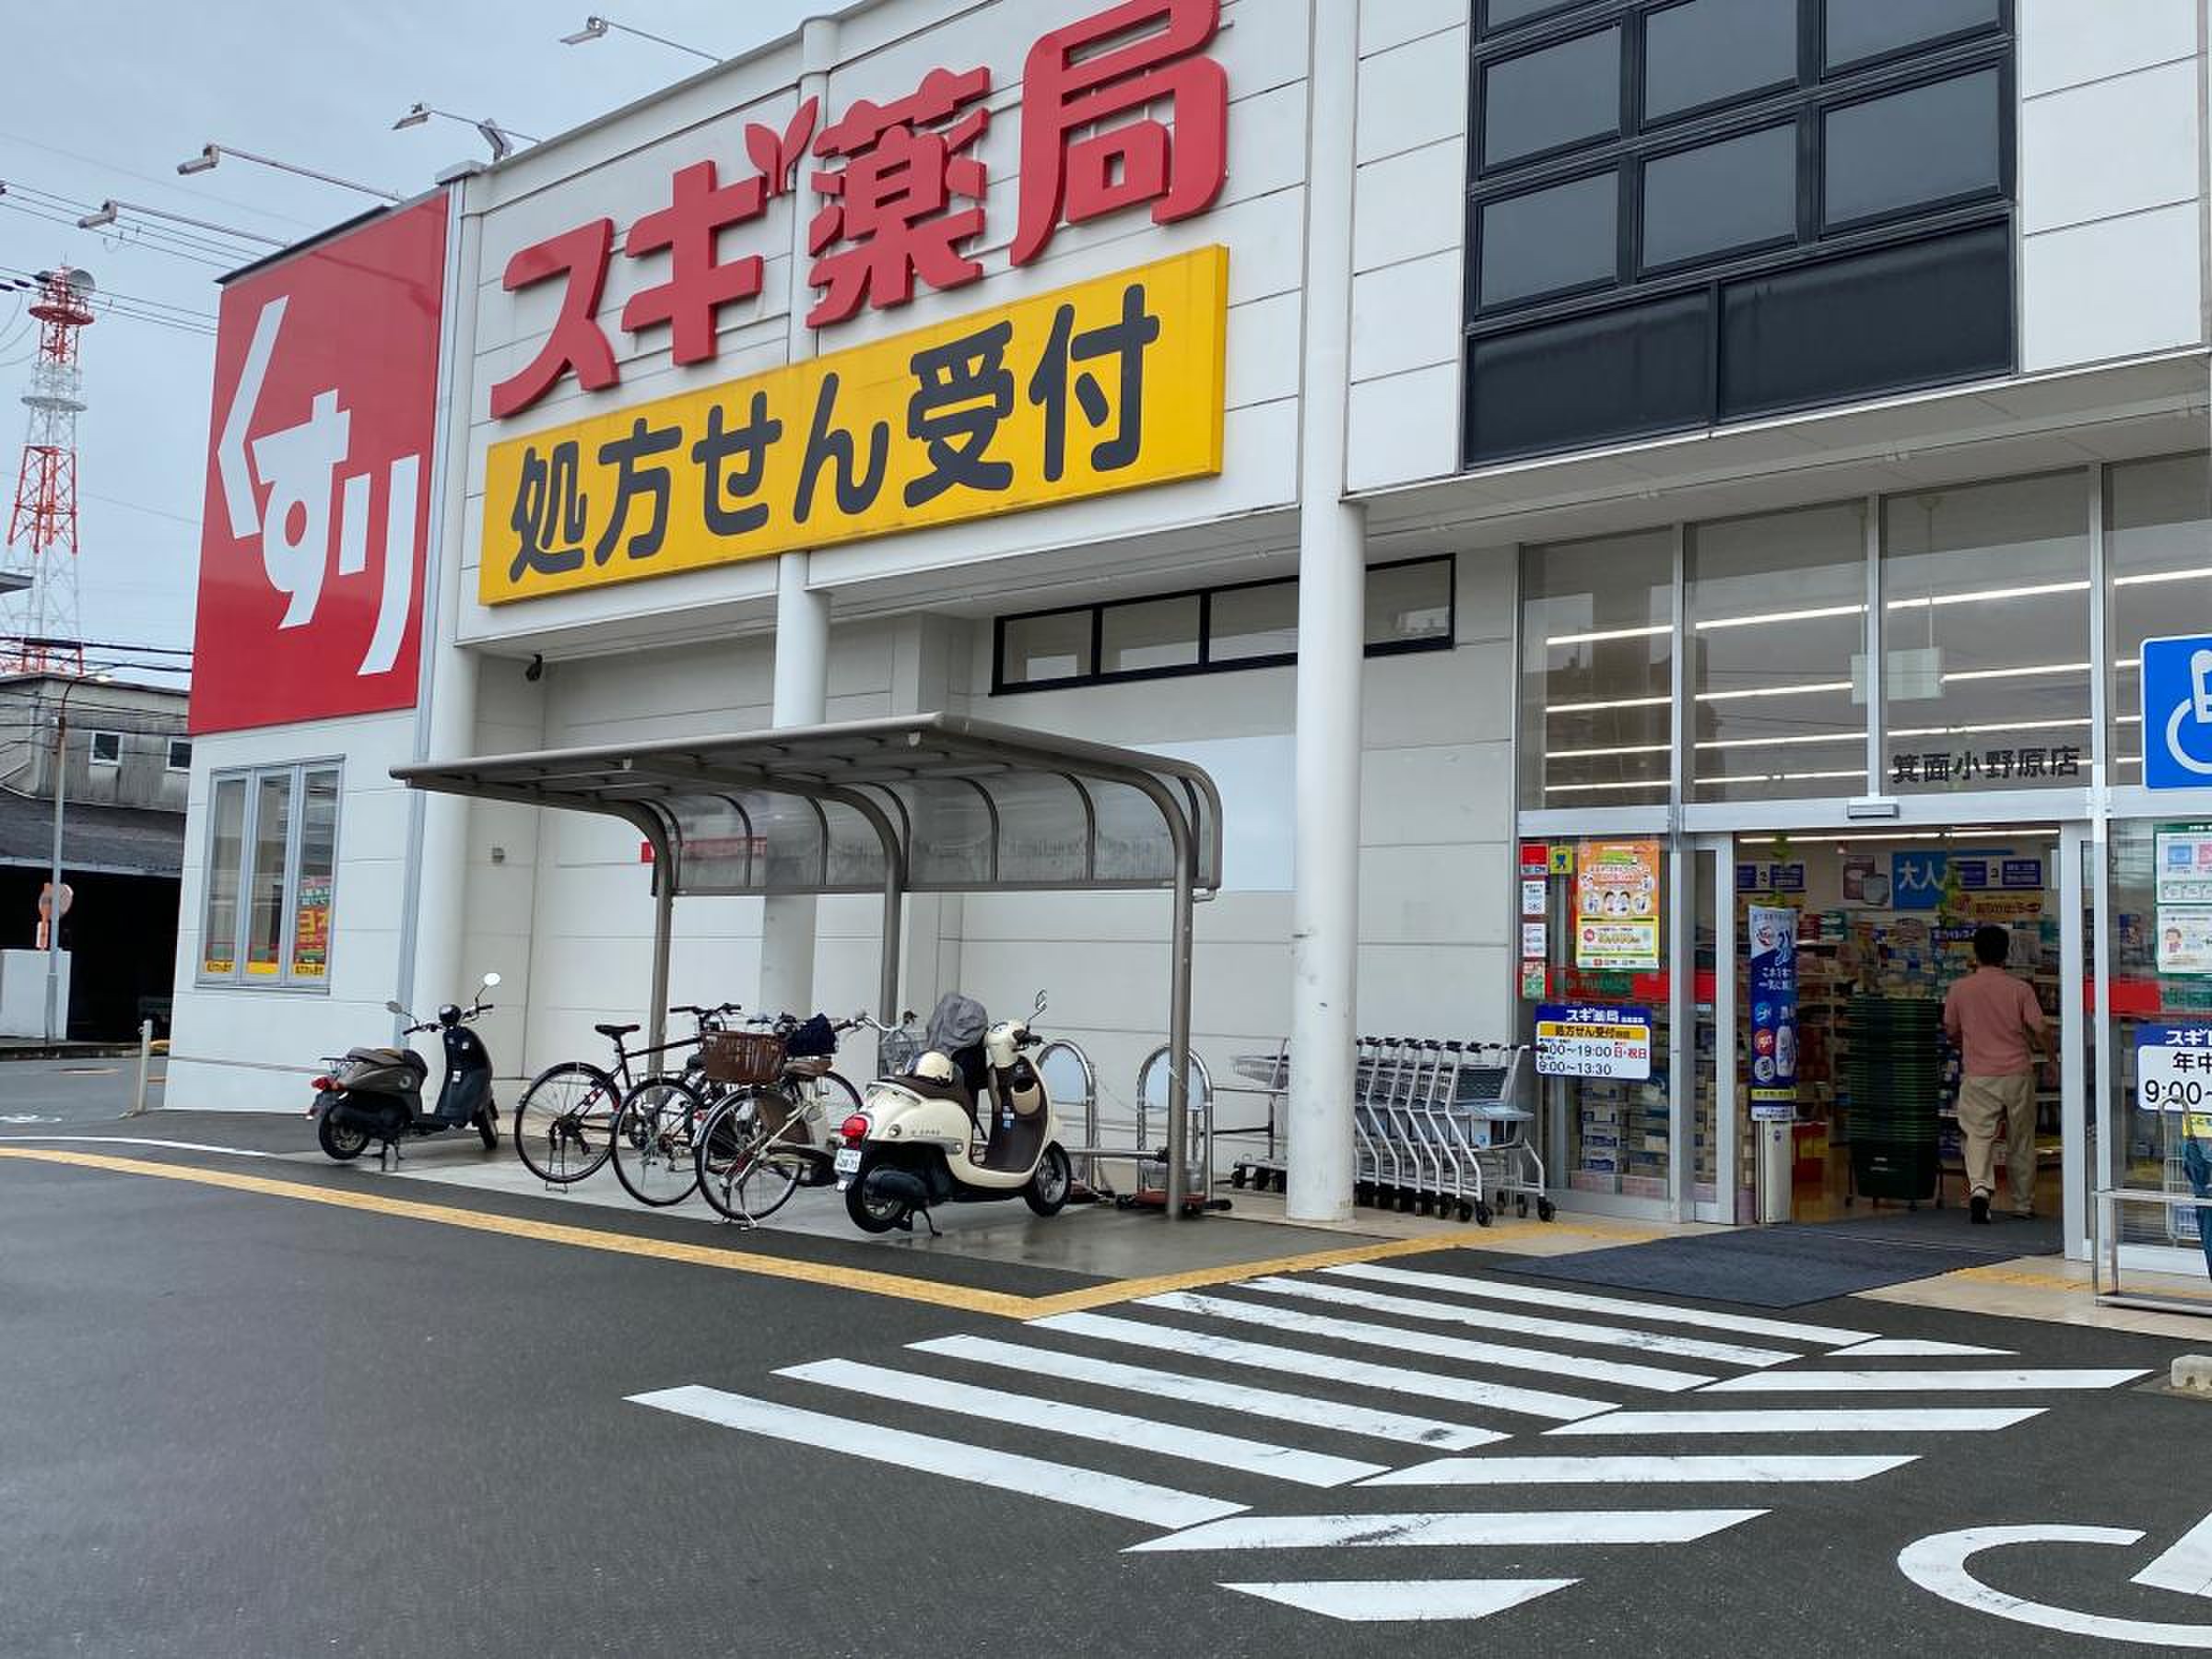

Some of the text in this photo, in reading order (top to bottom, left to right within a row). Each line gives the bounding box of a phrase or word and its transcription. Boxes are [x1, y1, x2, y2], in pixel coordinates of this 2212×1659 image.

[490, 0, 1228, 419] スギ薬局
[218, 295, 420, 677] くすり
[509, 283, 1159, 583] 処方せん受付
[1892, 745, 2080, 783] 箕面小野原店
[1566, 1007, 1619, 1023] スギ薬局
